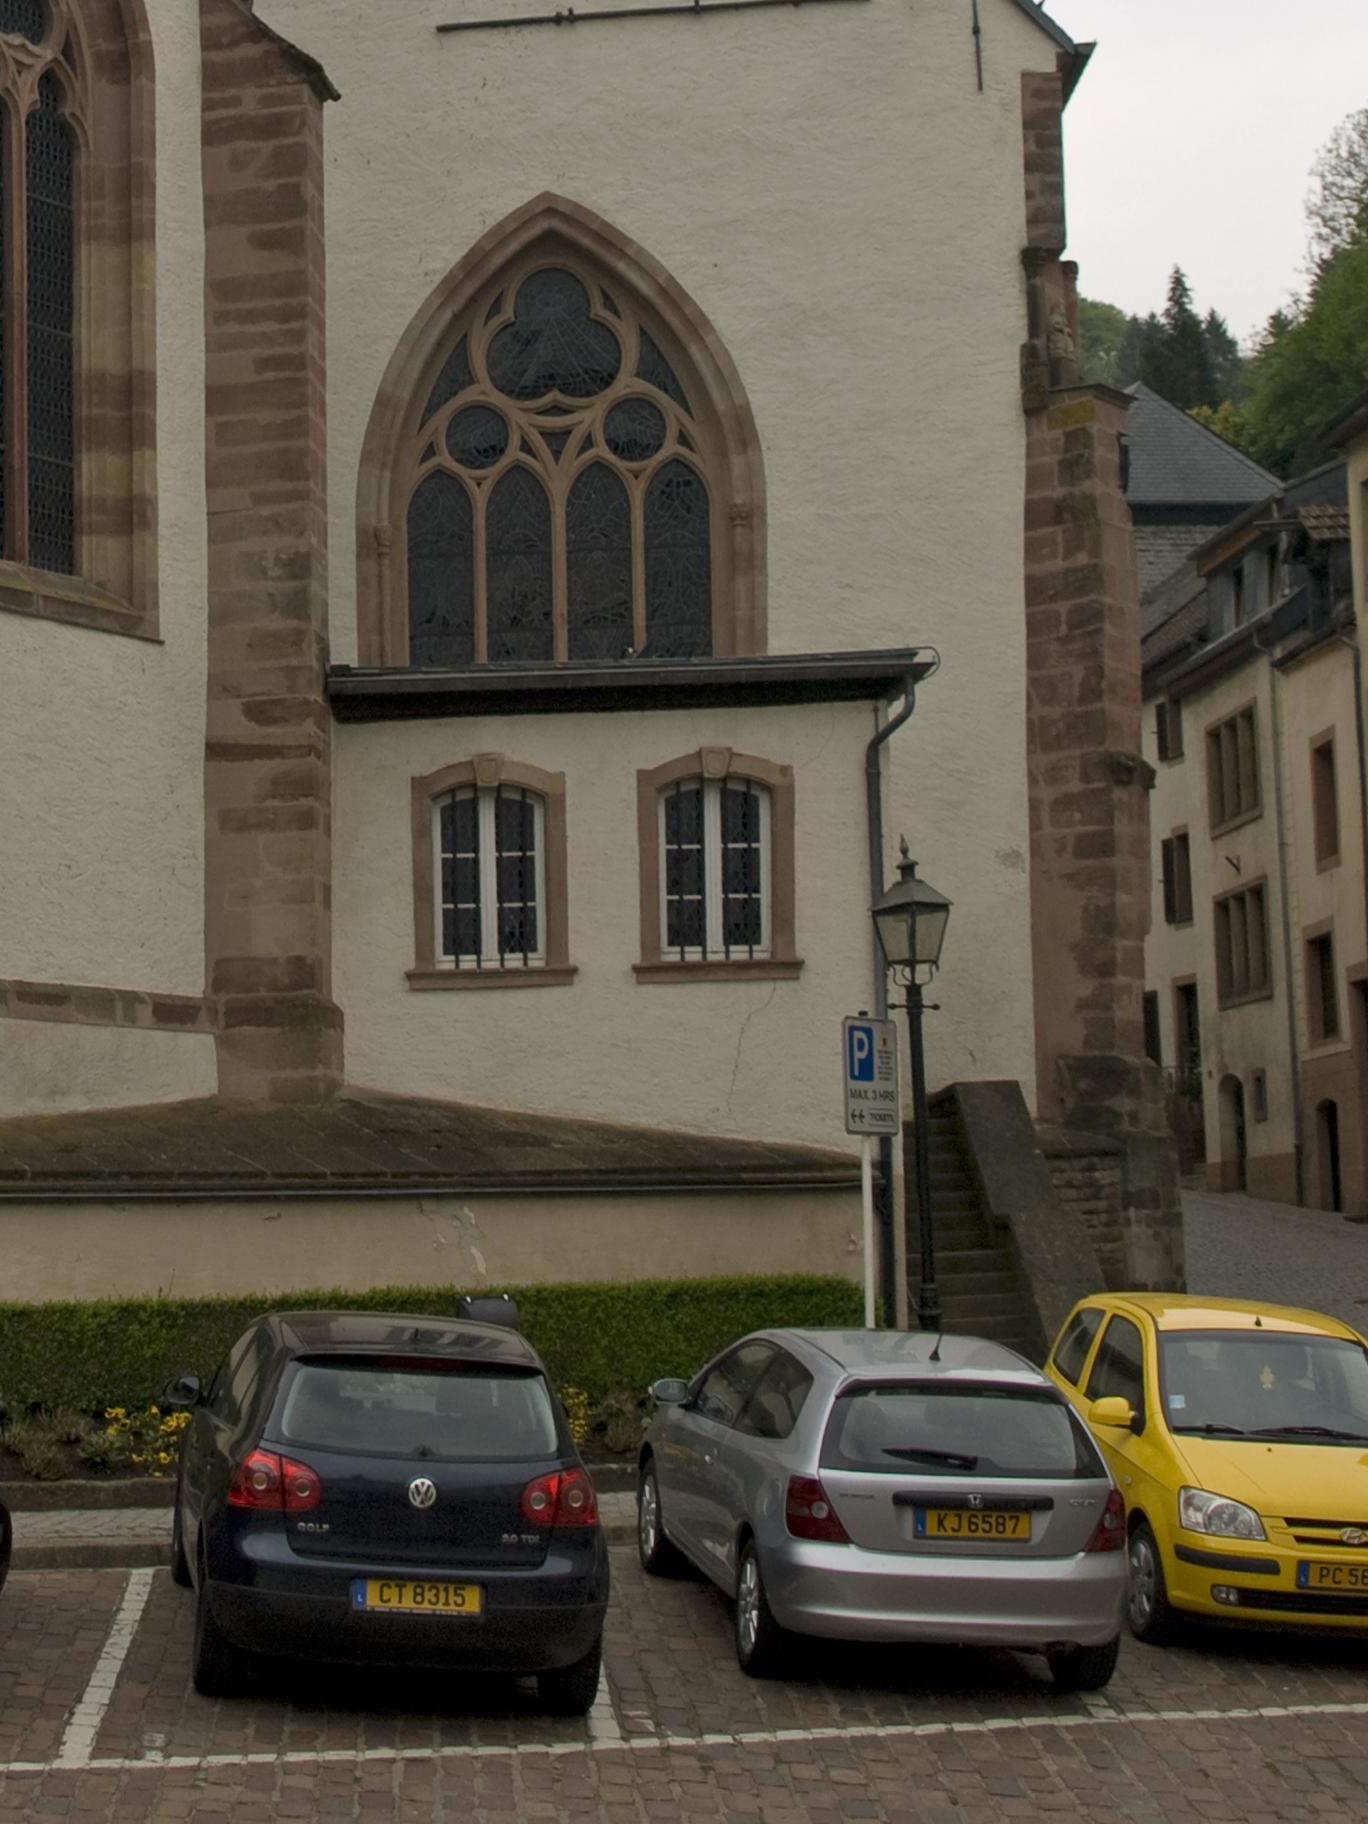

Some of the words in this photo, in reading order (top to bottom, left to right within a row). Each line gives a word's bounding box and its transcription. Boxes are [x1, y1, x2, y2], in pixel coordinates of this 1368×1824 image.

[853, 1030, 870, 1076] P
[936, 1512, 963, 1533] KJ
[967, 1512, 1021, 1535] 6587
[1318, 1566, 1343, 1585] PC
[379, 1582, 407, 1604] CT
[412, 1583, 467, 1608] 8315
